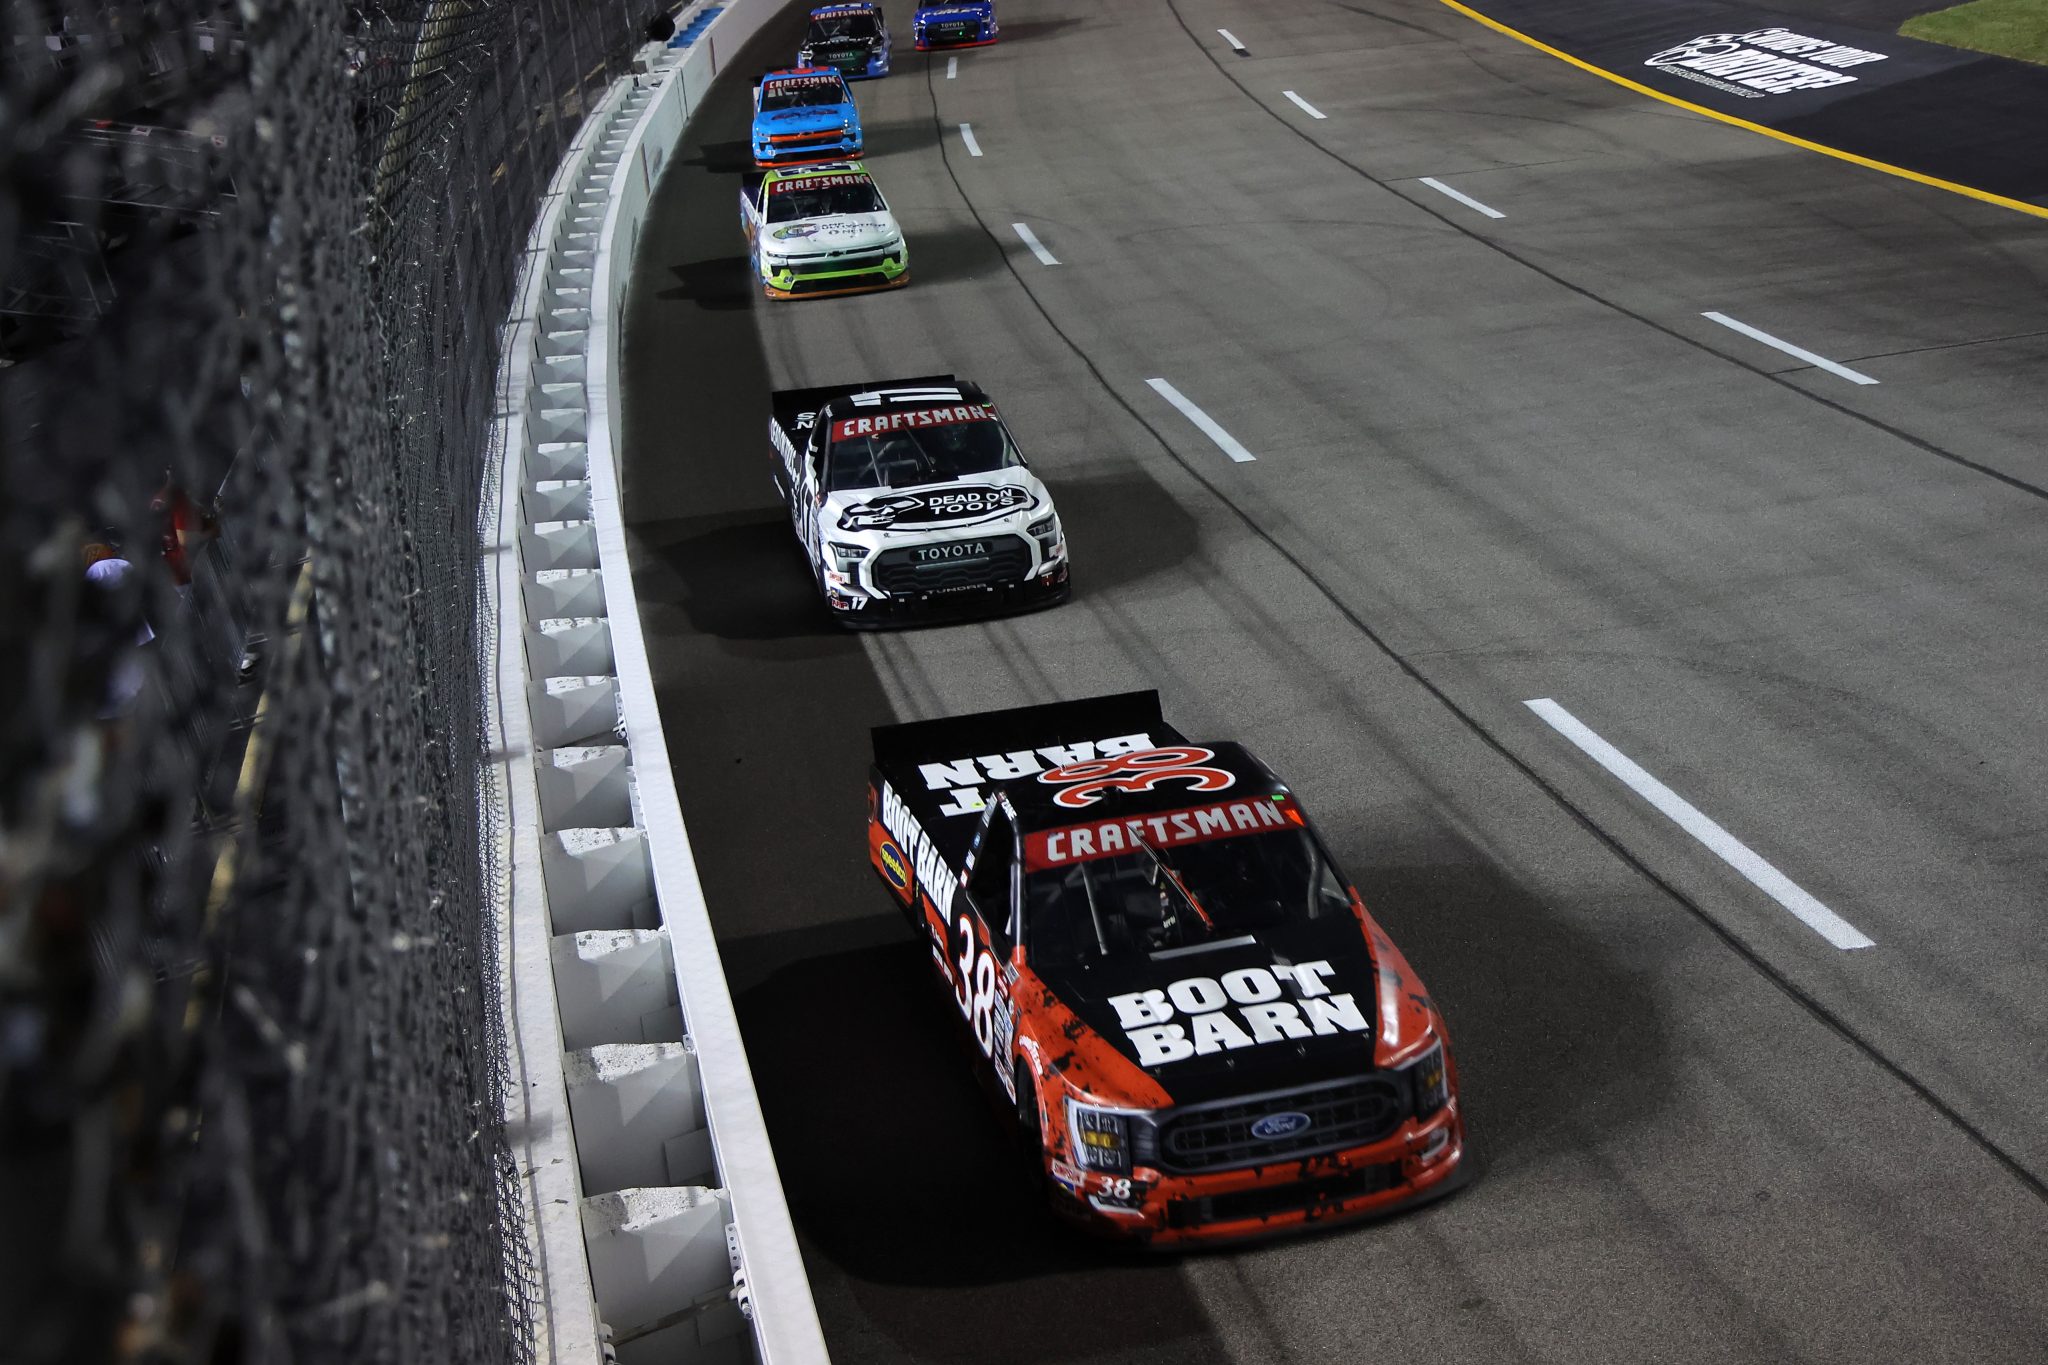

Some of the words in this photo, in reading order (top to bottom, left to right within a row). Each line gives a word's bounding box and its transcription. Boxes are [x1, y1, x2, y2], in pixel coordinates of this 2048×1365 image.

[815, 9, 874, 20] CRAFTSMAN
[828, 51, 854, 59] TOYOTA
[769, 75, 837, 89] CRAFTSMAN
[776, 174, 867, 193] CRAFTSMAN
[843, 405, 987, 437] CRAFTSMAN
[929, 493, 981, 507] DEAD
[986, 489, 1012, 501] ON
[930, 498, 1015, 515] TOOLS
[918, 543, 985, 561] TOYOTA
[926, 584, 987, 595] TUNDRA
[851, 596, 868, 610] 17
[1047, 801, 1285, 862] CRAFTSMAN
[883, 779, 922, 866] BOOT
[915, 829, 958, 927] BARN
[955, 916, 995, 1058] 38
[1107, 960, 1336, 1031] BOOT
[1125, 992, 1371, 1067] BARN
[1097, 1175, 1131, 1200] 38
